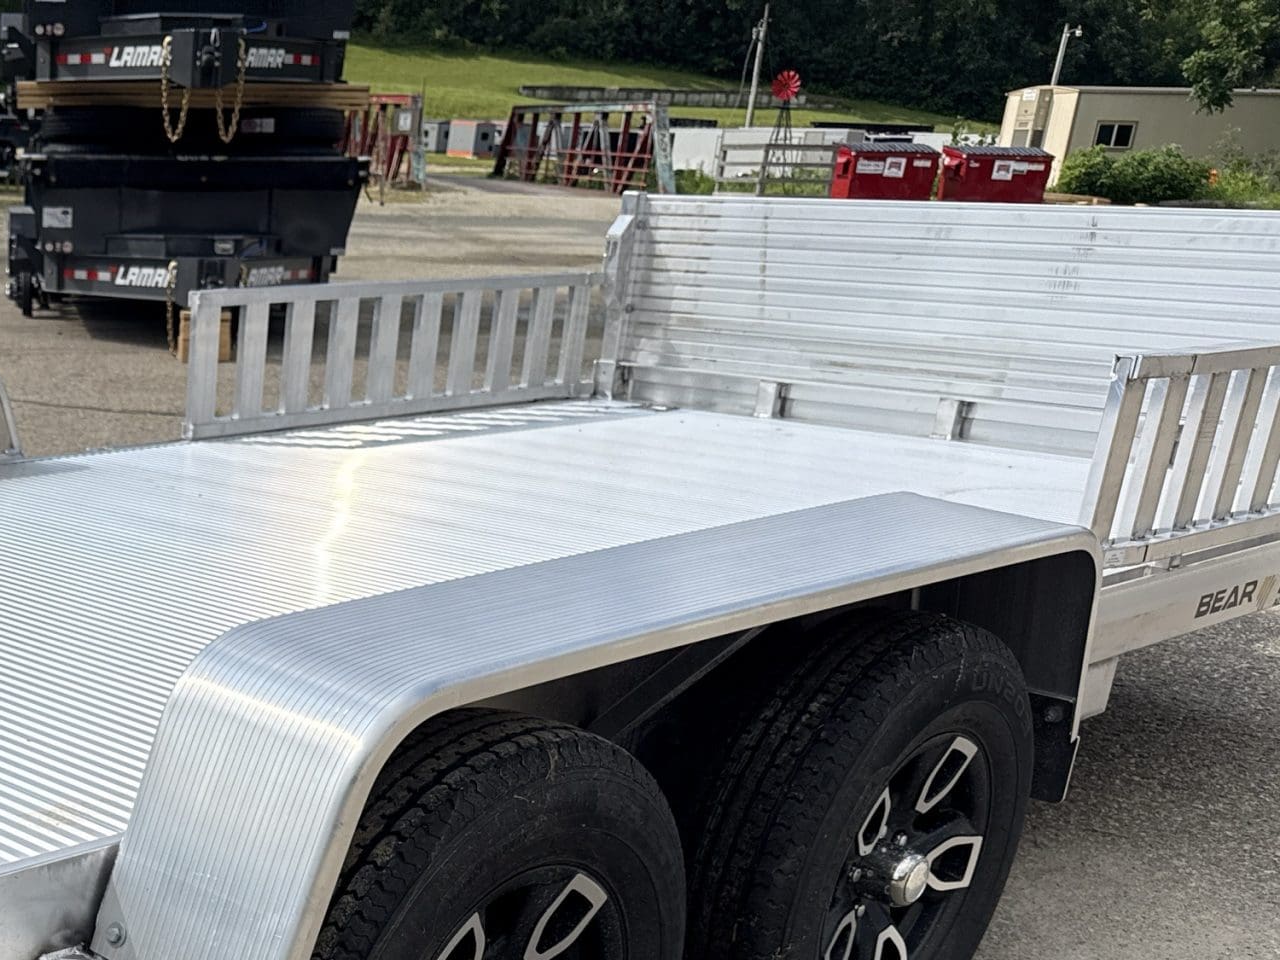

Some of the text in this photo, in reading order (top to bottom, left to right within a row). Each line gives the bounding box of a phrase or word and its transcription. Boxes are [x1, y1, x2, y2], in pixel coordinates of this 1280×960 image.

[237, 46, 286, 69] AMAR
[239, 266, 285, 288] AMAR
[1194, 579, 1258, 619] BEAR
